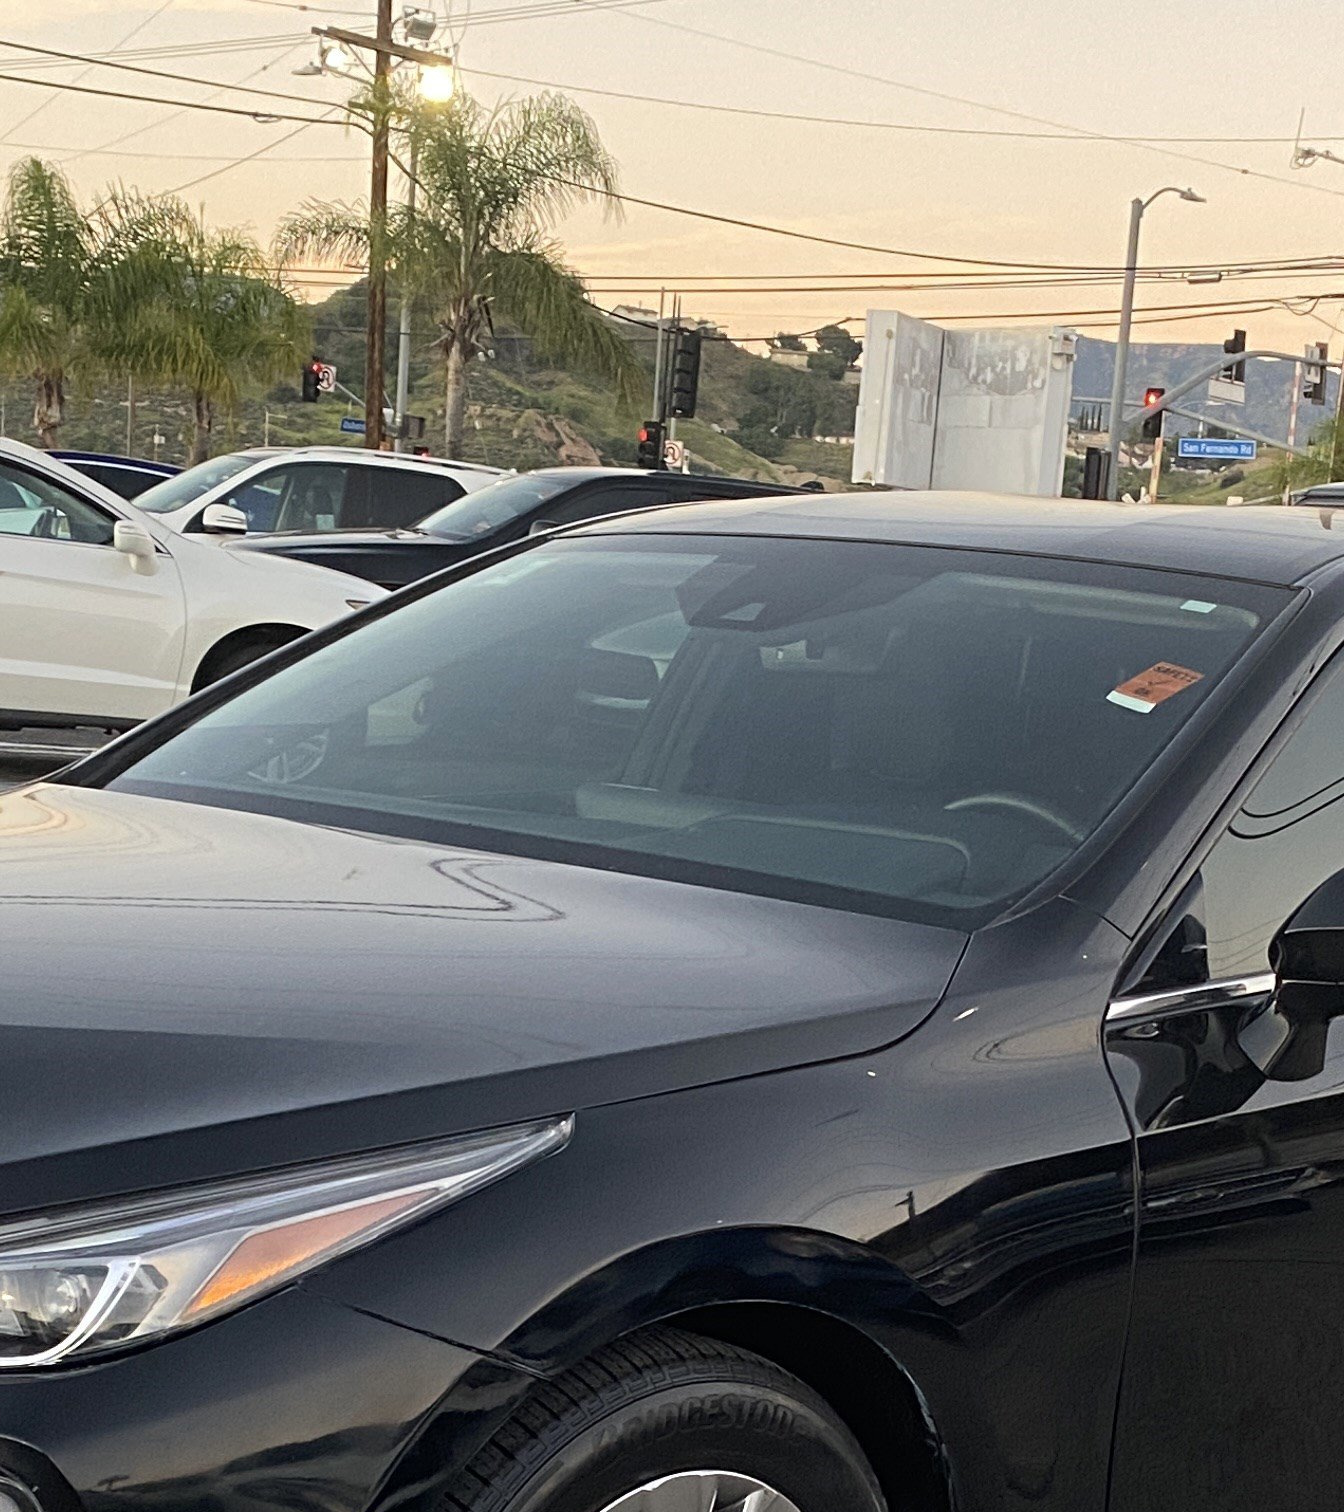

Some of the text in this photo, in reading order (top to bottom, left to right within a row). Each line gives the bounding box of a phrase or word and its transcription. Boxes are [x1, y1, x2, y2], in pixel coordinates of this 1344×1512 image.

[1183, 443, 1252, 454] San Fernando Rd
